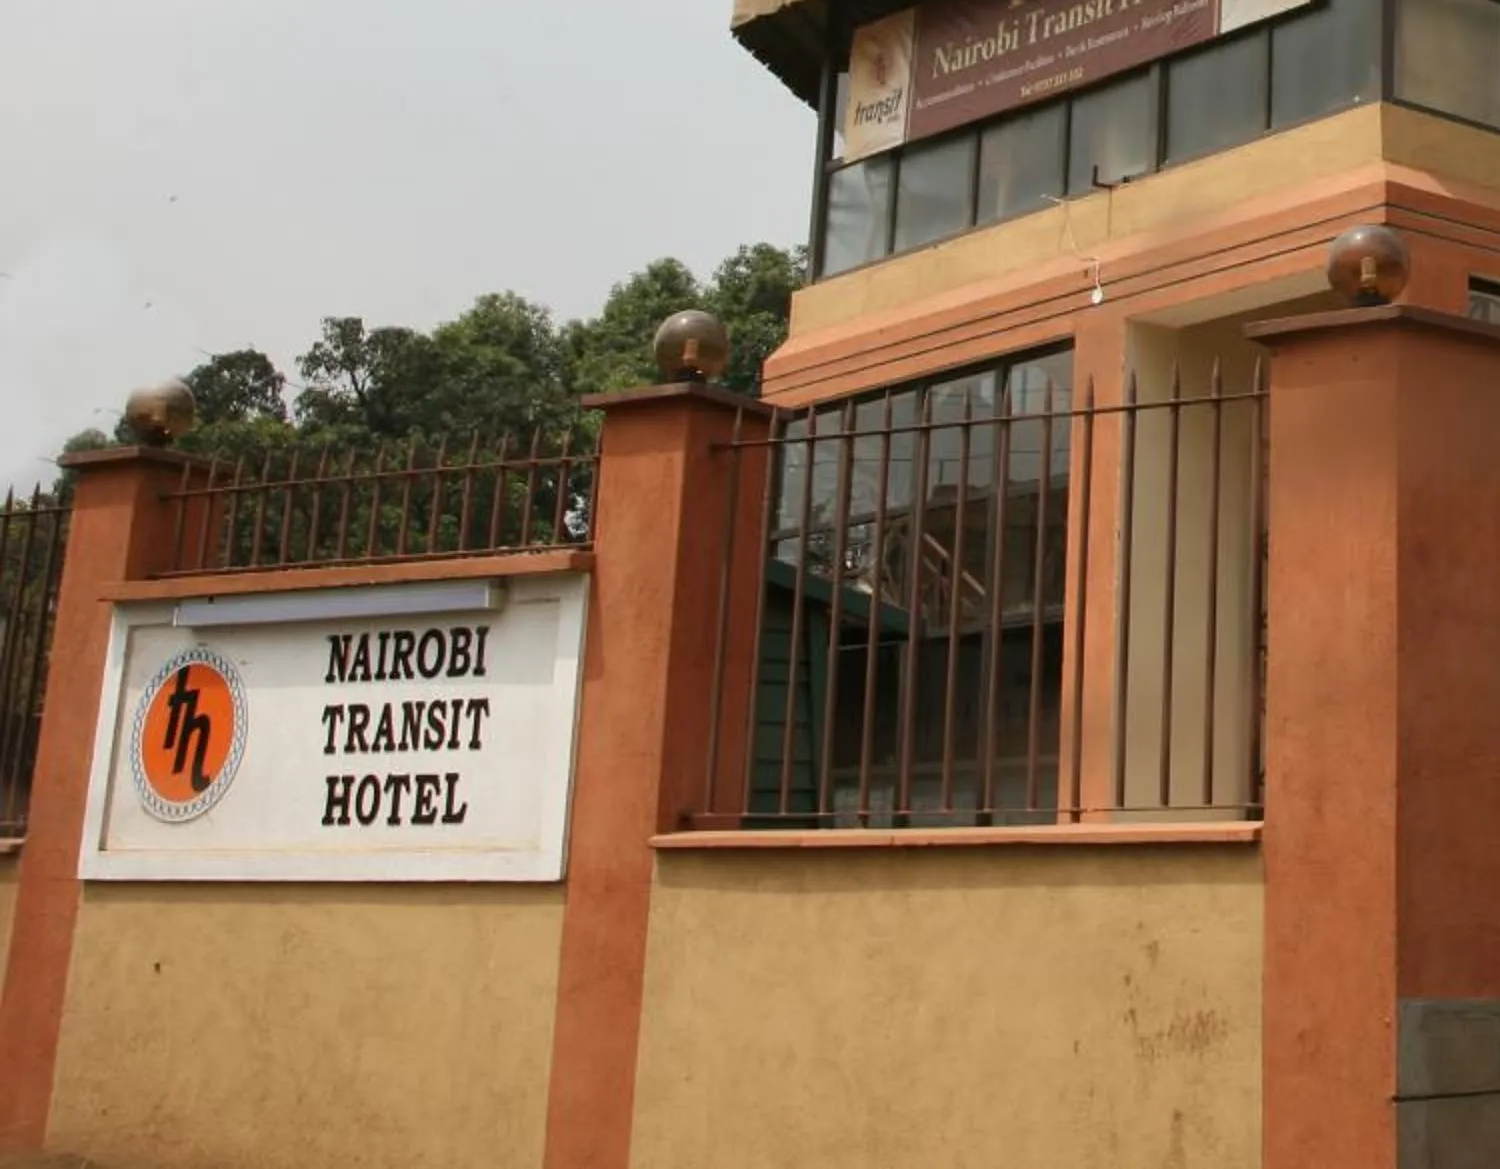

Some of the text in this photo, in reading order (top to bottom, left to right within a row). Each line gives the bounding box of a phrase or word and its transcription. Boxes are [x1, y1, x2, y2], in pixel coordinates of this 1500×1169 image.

[932, 19, 1020, 79] Nairobi
[323, 626, 491, 684] NAIROBI
[321, 697, 491, 755] TRANSIT
[321, 773, 468, 827] HOTEL
